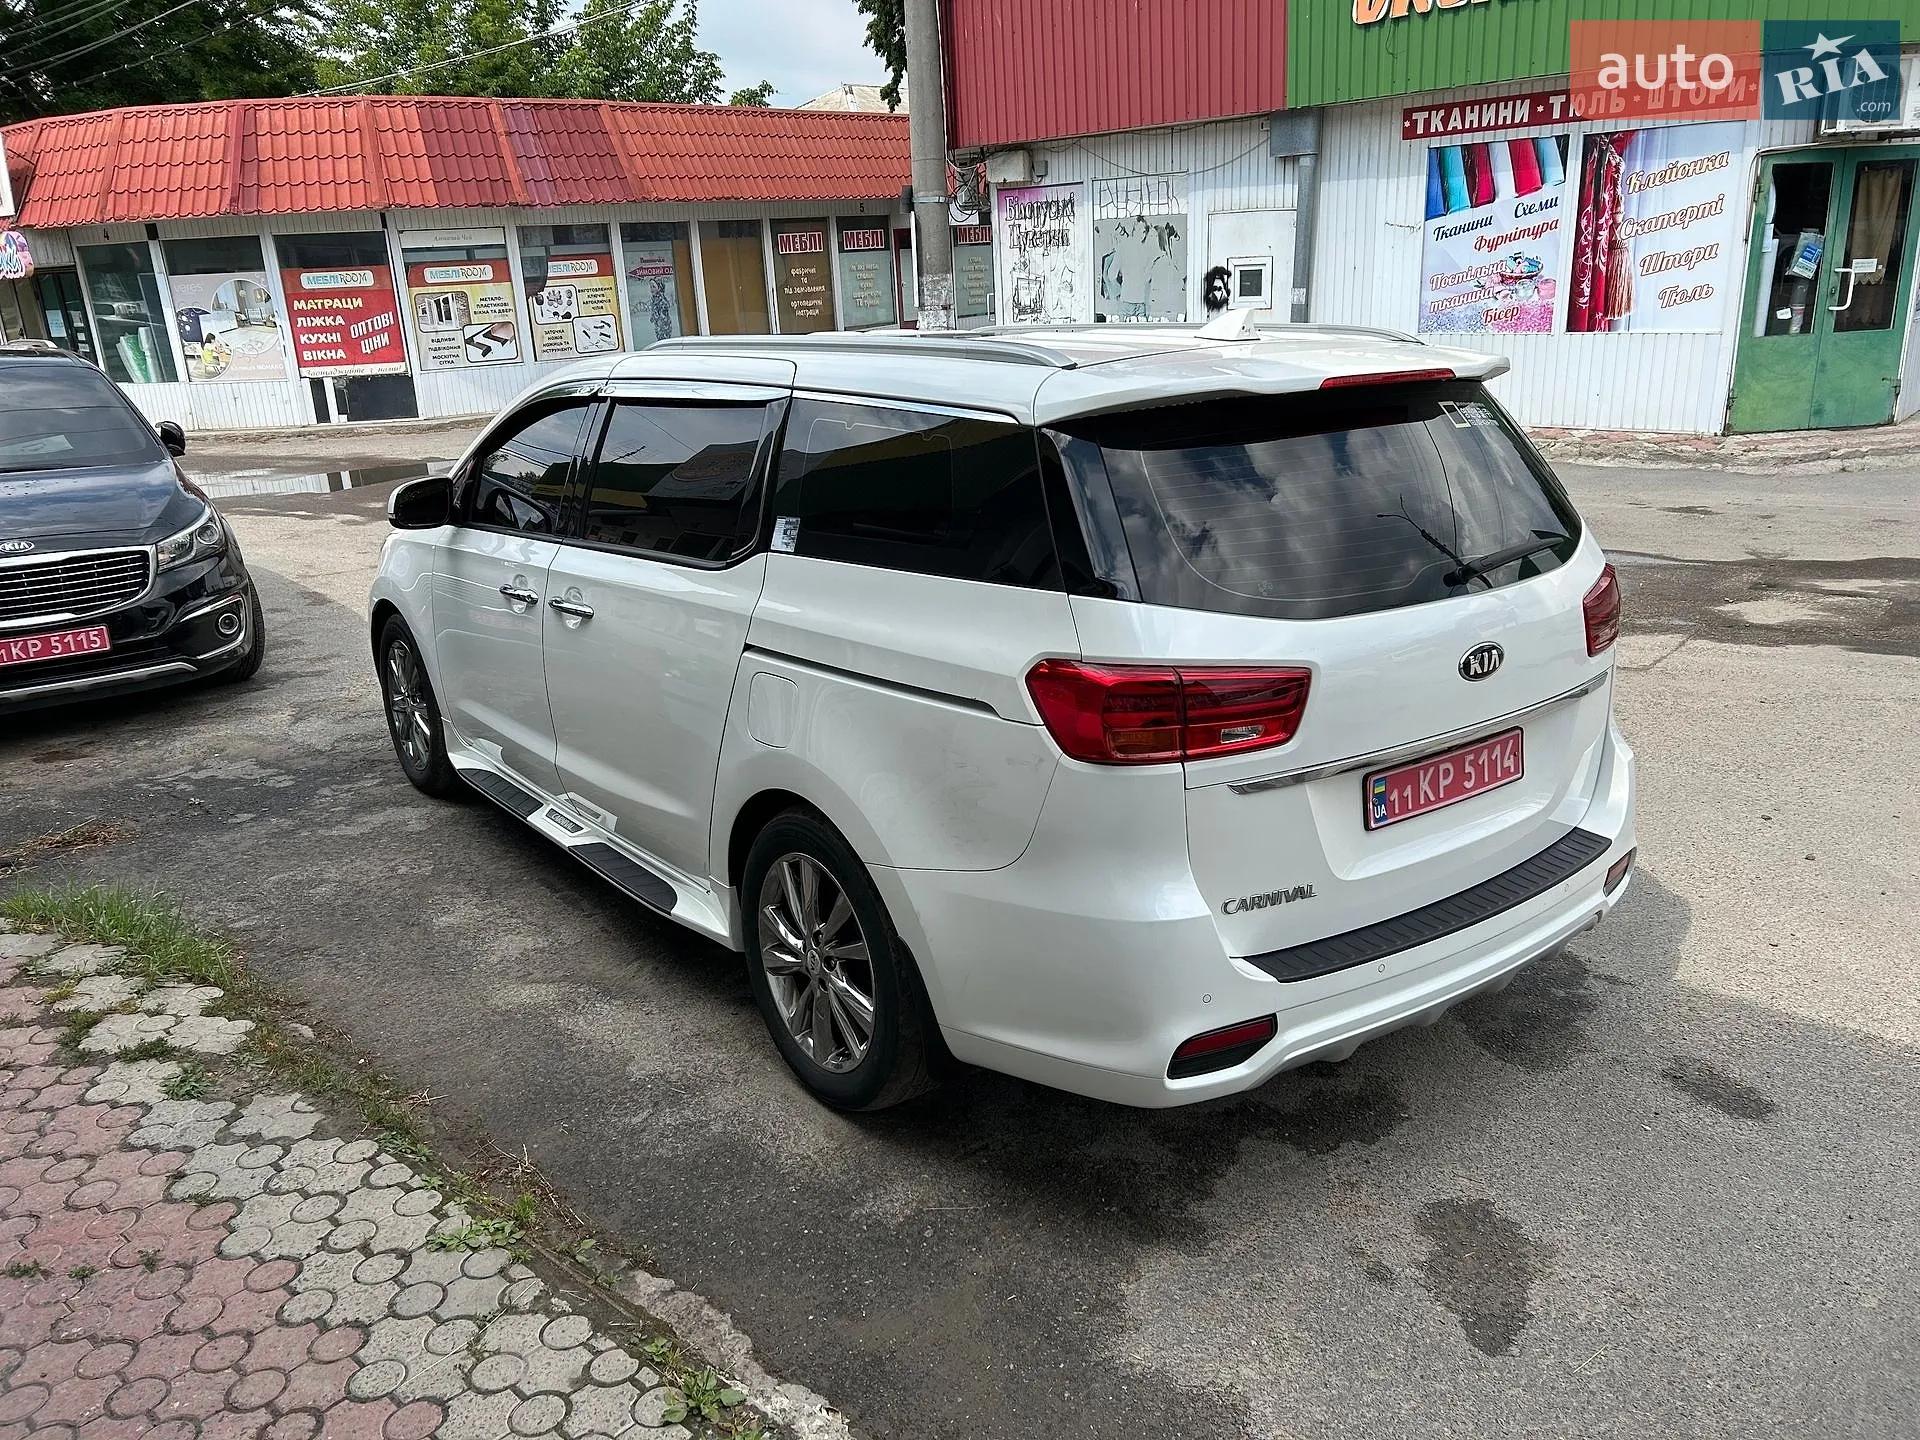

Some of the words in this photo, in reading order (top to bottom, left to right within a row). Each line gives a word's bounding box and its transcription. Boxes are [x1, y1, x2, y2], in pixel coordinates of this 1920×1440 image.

[1412, 98, 1531, 135] ТКАНИНИ
[1549, 87, 1627, 120] ТЮЛЬ
[1647, 75, 1747, 110] ШТОРИ
[1626, 151, 1730, 195] Клейонка
[1514, 196, 1559, 219] Схеми
[1620, 193, 1725, 240] Скатерті
[843, 229, 885, 251] МЕБЛІ
[957, 224, 992, 245] МЕБЛІ
[1433, 215, 1494, 242] Тканини
[1473, 218, 1560, 253] Фурнітура
[778, 231, 824, 255] МЕБЛІ
[1639, 243, 1719, 276] Штори
[1429, 260, 1507, 291] Постільна
[293, 297, 363, 311] МАТРАЦИ
[1429, 286, 1495, 313] тканина
[1658, 283, 1714, 309] Тюль
[296, 315, 345, 328] ЛІЖКА
[349, 311, 395, 339] ОПТОВІ
[1482, 306, 1520, 324] Бісер
[300, 332, 342, 345] КУХНІ
[360, 332, 390, 355] ЦІНИ
[302, 348, 347, 361] ВІКНА
[4, 541, 30, 551] KIA
[49, 630, 101, 655] 5115
[1468, 649, 1500, 676] KIA
[1463, 739, 1515, 790] 5114
[1374, 803, 1387, 819] UA
[1220, 882, 1319, 915] CARNIVAL
